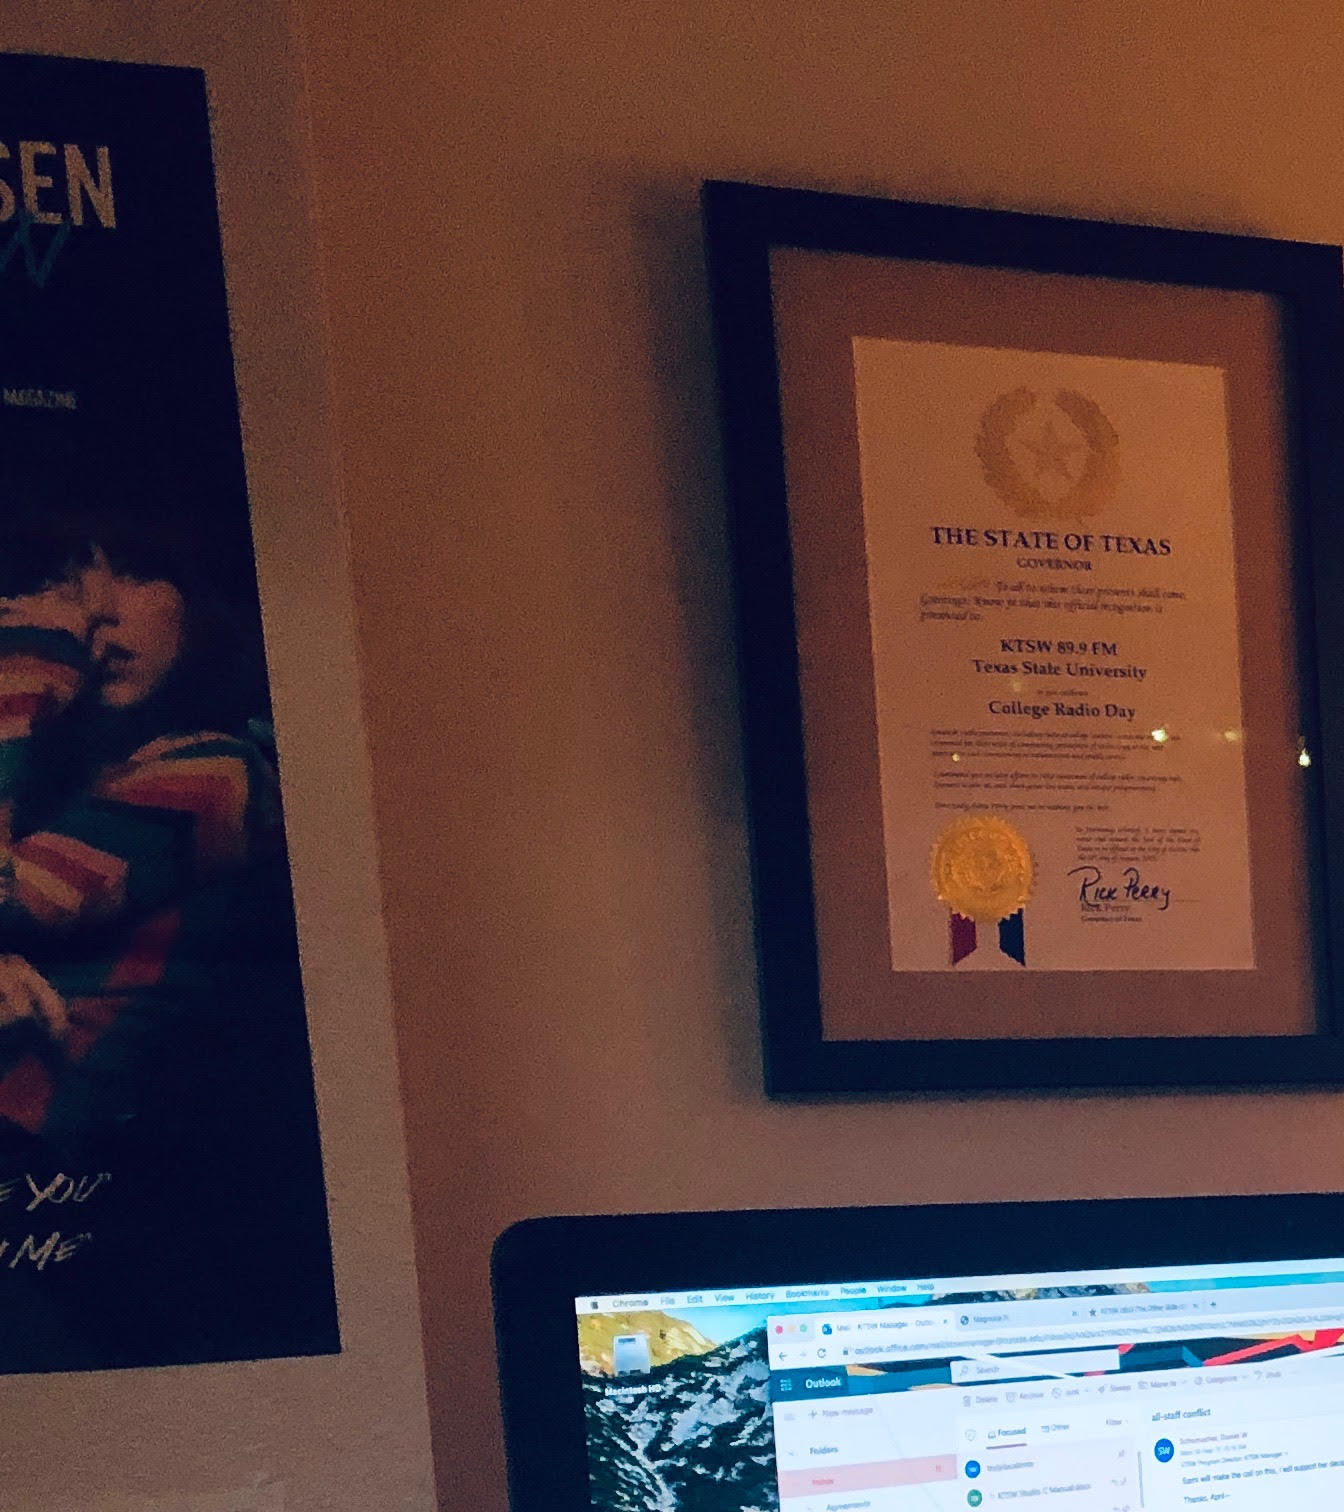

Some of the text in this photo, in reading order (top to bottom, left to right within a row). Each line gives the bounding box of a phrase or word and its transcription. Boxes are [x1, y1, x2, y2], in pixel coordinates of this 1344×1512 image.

[930, 527, 1172, 556] THE STATE OF TEXAS
[1016, 557, 1093, 571] GOVERNOR
[1000, 639, 1118, 656] KTSW 89.9 FM
[972, 659, 1148, 682] Texas State University
[988, 701, 1137, 722] College Radio Day
[612, 1298, 649, 1309] Chrome
[660, 1296, 676, 1306] File
[686, 1294, 704, 1305] Edit
[714, 1292, 735, 1303] View
[745, 1290, 775, 1302] History
[785, 1288, 830, 1299] Bookmarks
[876, 1282, 908, 1294] Window
[916, 1281, 935, 1292] Help
[604, 1382, 663, 1398] Macintosh HD
[805, 1376, 842, 1390] Outlook
[1151, 1407, 1212, 1422] all-staff conflict
